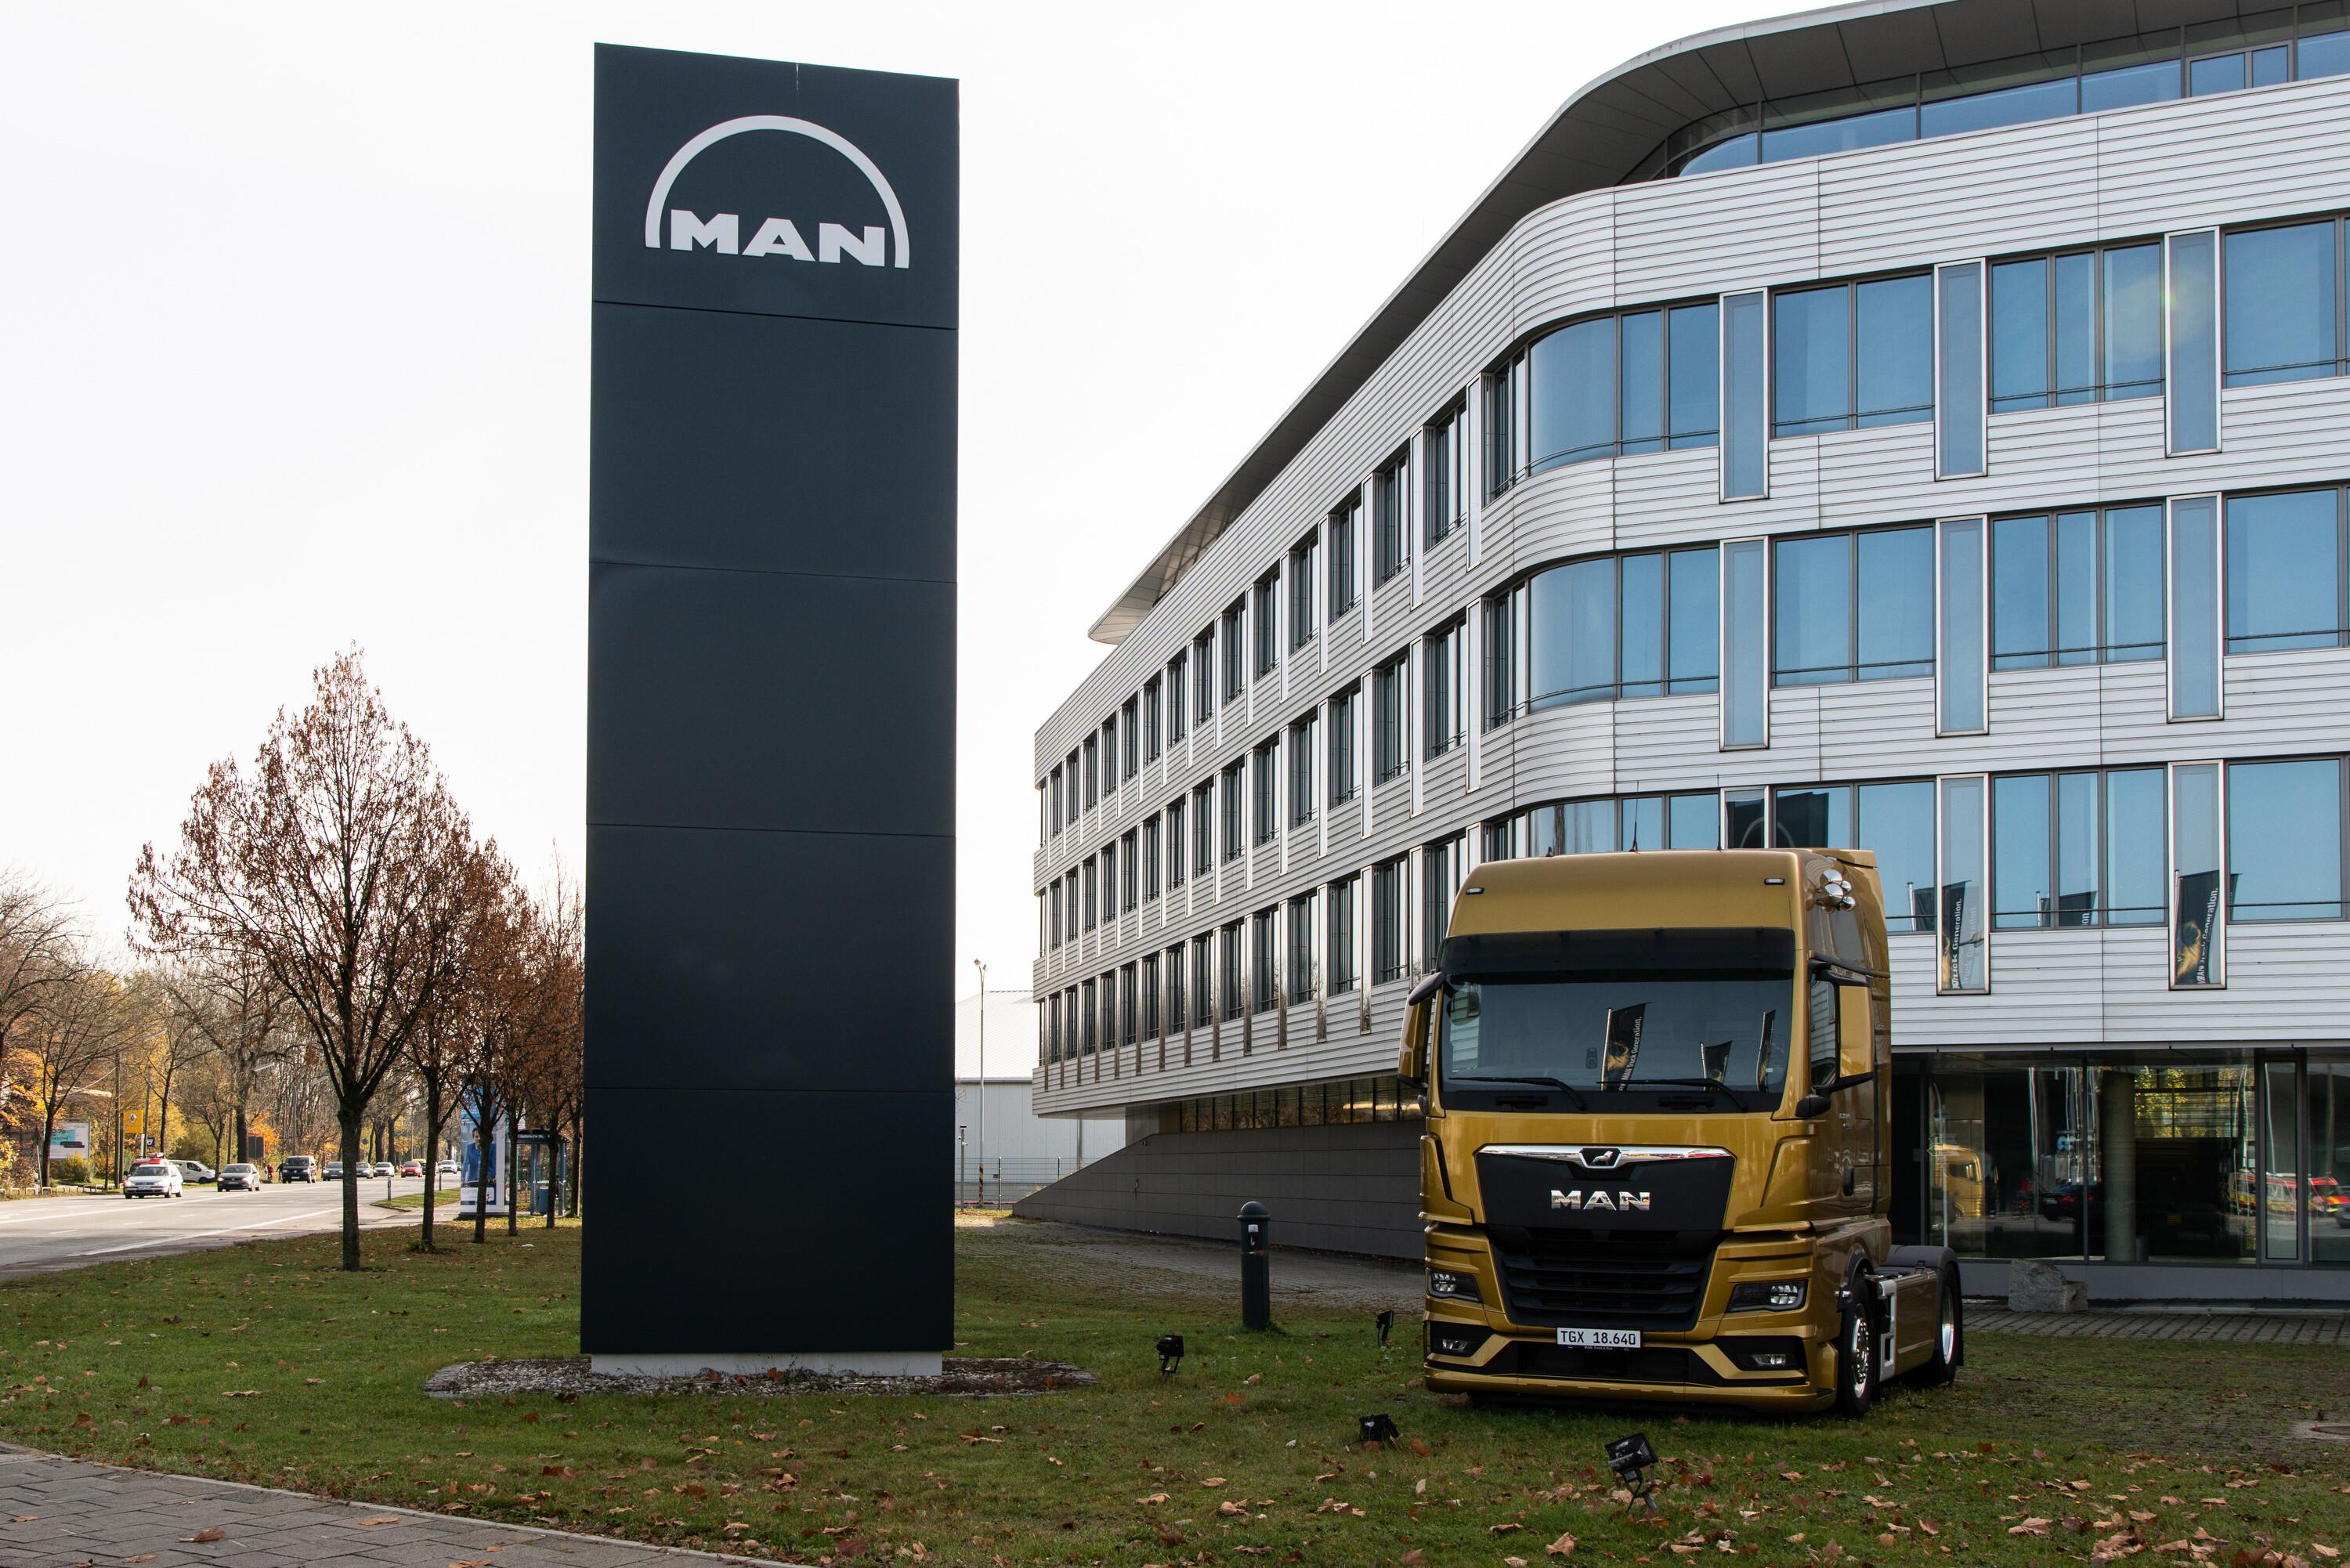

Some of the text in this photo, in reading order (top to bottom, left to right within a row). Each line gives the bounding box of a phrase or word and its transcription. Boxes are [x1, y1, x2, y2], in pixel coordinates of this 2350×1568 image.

[671, 209, 885, 267] MAN
[1952, 898, 1962, 950] Generation.
[1631, 1017, 1642, 1053] Generation.
[1551, 1190, 1650, 1211] MAN
[1560, 1331, 1636, 1345] TGX 18.640
